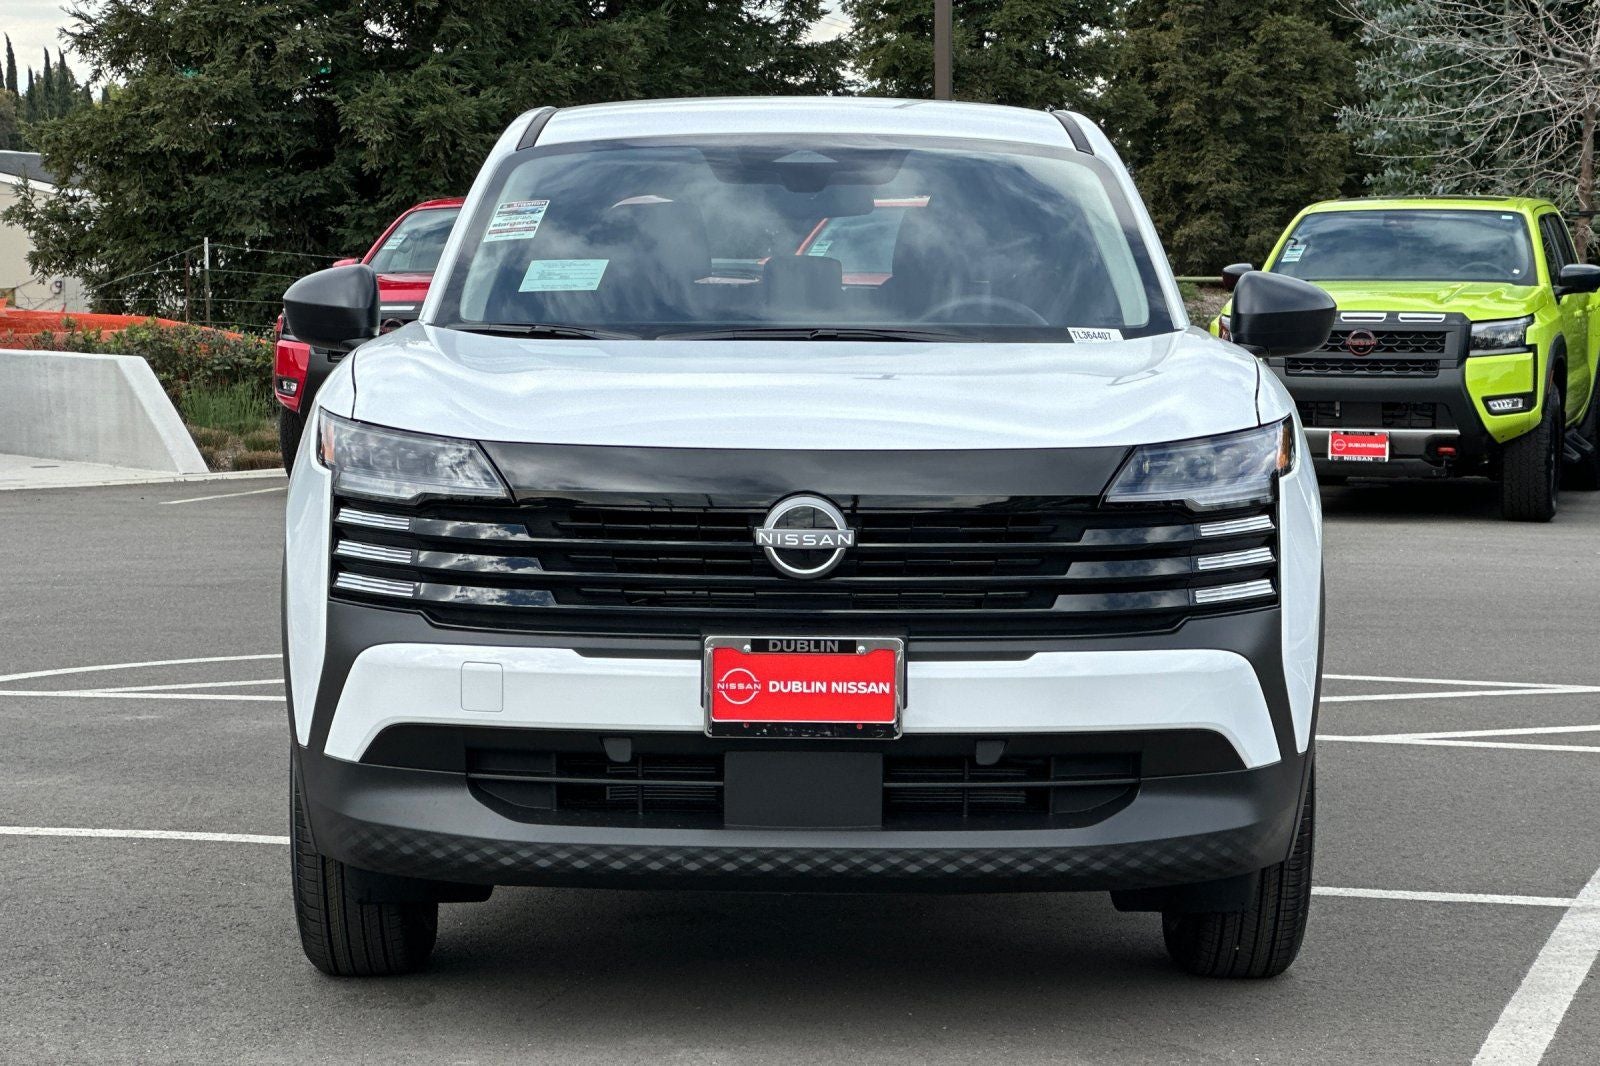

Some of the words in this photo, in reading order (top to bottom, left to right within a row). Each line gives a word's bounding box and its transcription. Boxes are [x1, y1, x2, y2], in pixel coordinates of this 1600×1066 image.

[1072, 331, 1111, 340] TL364407
[758, 532, 853, 546] NISSAN
[768, 640, 839, 652] DUBLIN
[769, 681, 826, 693] DUBLIN
[831, 682, 890, 694] NISSAN
